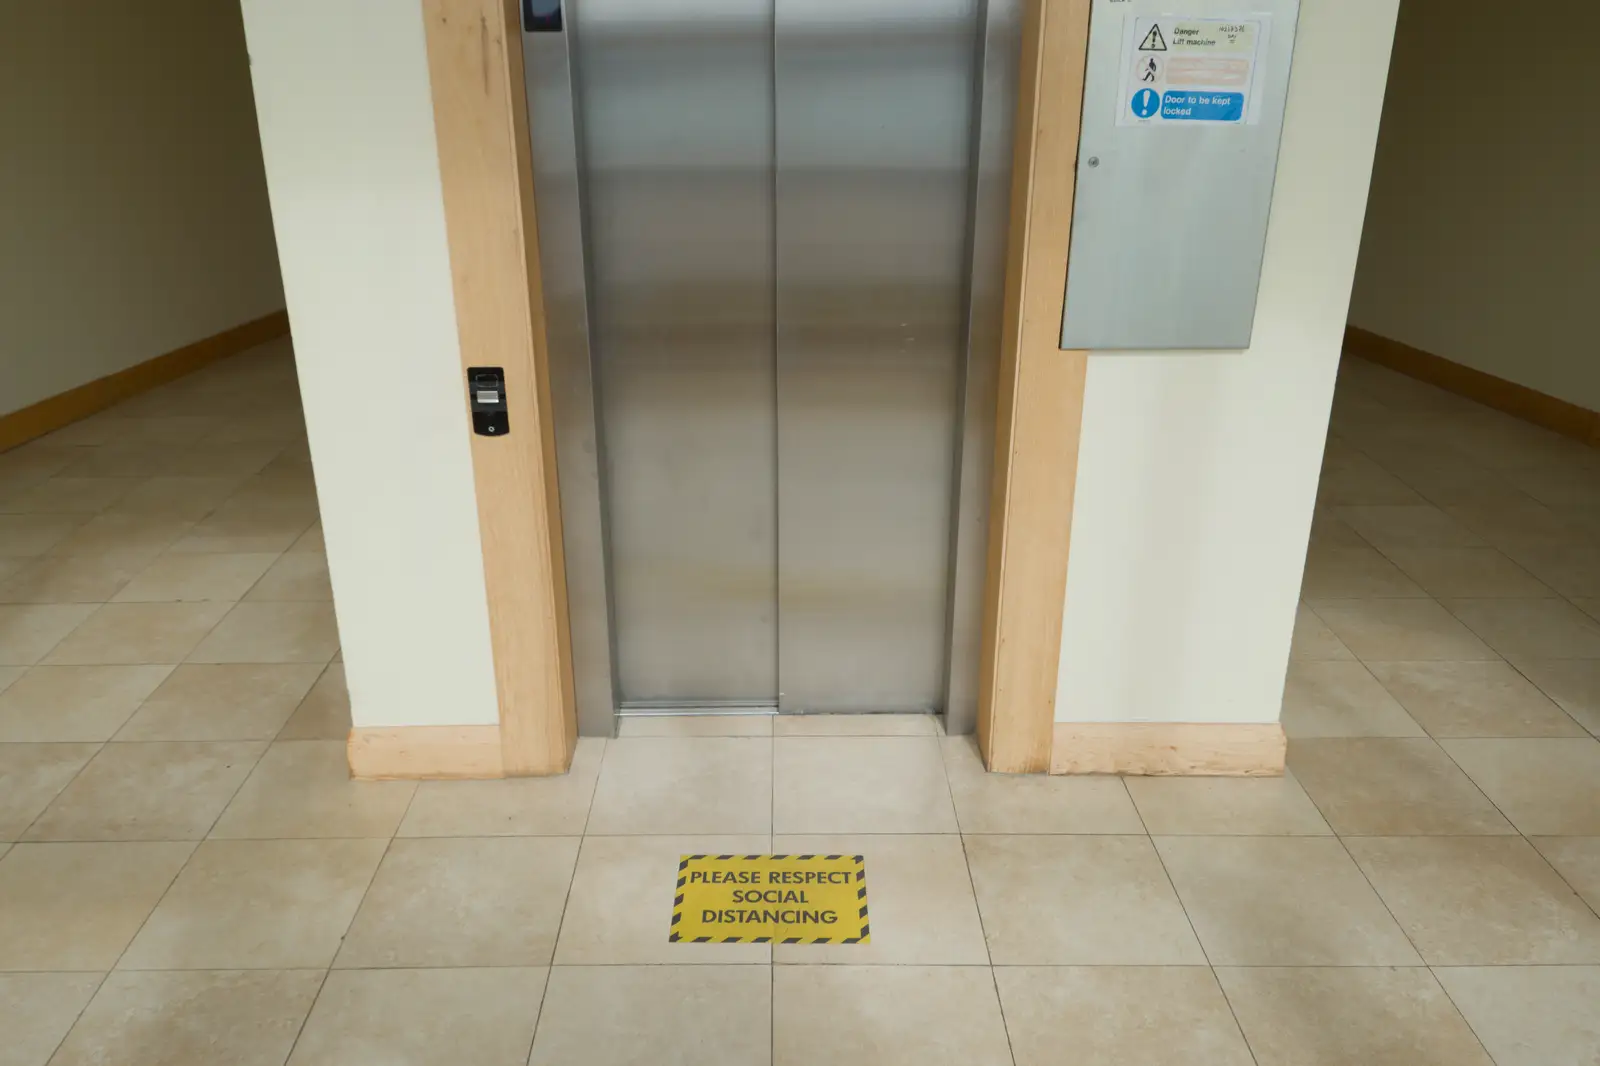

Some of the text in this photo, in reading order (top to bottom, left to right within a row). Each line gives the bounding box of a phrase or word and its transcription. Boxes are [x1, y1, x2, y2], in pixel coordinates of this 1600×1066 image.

[1173, 27, 1199, 37] Danger
[1172, 38, 1216, 47] Lift machine
[1165, 95, 1231, 106] Door to be kept
[1163, 106, 1192, 116] locked
[690, 871, 852, 885] PLEASE RESPECT
[732, 890, 809, 903] SOCIAL
[702, 909, 838, 924] DISTANCING
